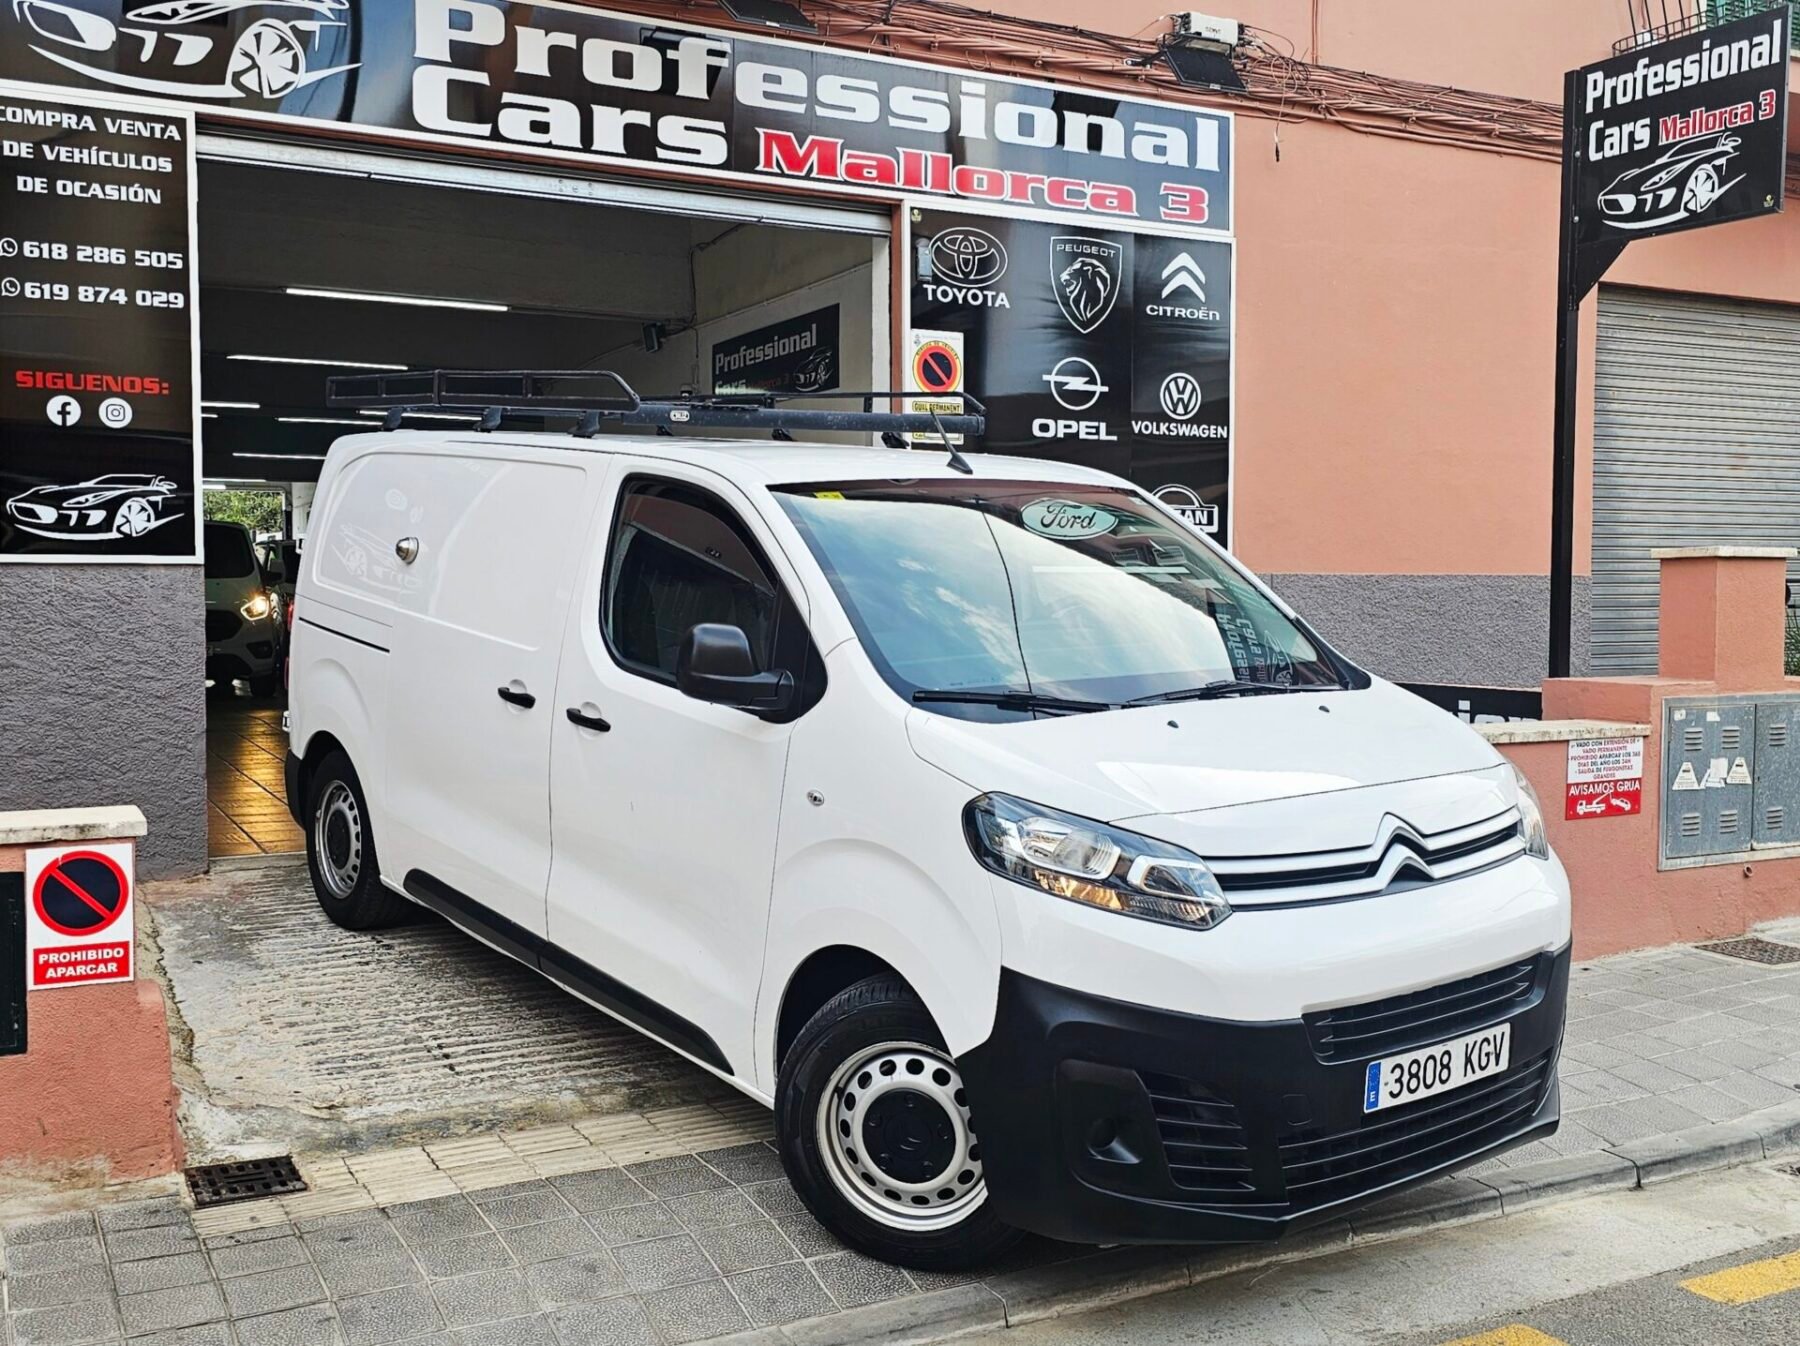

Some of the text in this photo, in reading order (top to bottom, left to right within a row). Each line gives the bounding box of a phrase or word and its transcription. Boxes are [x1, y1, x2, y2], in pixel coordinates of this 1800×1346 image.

[1585, 18, 1783, 115] Professional
[413, 0, 1221, 172] Professional
[104, 117, 182, 141] VENTA
[1588, 88, 1777, 163] Cars Mallorca 3
[2, 140, 173, 173] DE VEHÍCULOS
[412, 64, 1209, 224] Cars Mallorca 3
[17, 175, 161, 204] DE OCASIÓN
[23, 240, 184, 269] 618 286 505
[1056, 243, 1117, 259] PEUGEOT
[24, 281, 185, 309] 619 874 029
[922, 284, 1011, 309] TOYOTA
[715, 323, 817, 375] Professional
[16, 370, 170, 395] SIGUENOS:
[1032, 418, 1118, 441] OPEL
[1131, 420, 1229, 440] VOLKSWAGEN
[1041, 505, 1097, 530] Ford
[1569, 780, 1641, 796] AVISAMOS GRUA
[38, 947, 125, 965] PROHIBIDO
[45, 962, 118, 979] APARCAR
[1388, 1031, 1505, 1099] 3808 KGV
[1369, 1090, 1376, 1102] E
